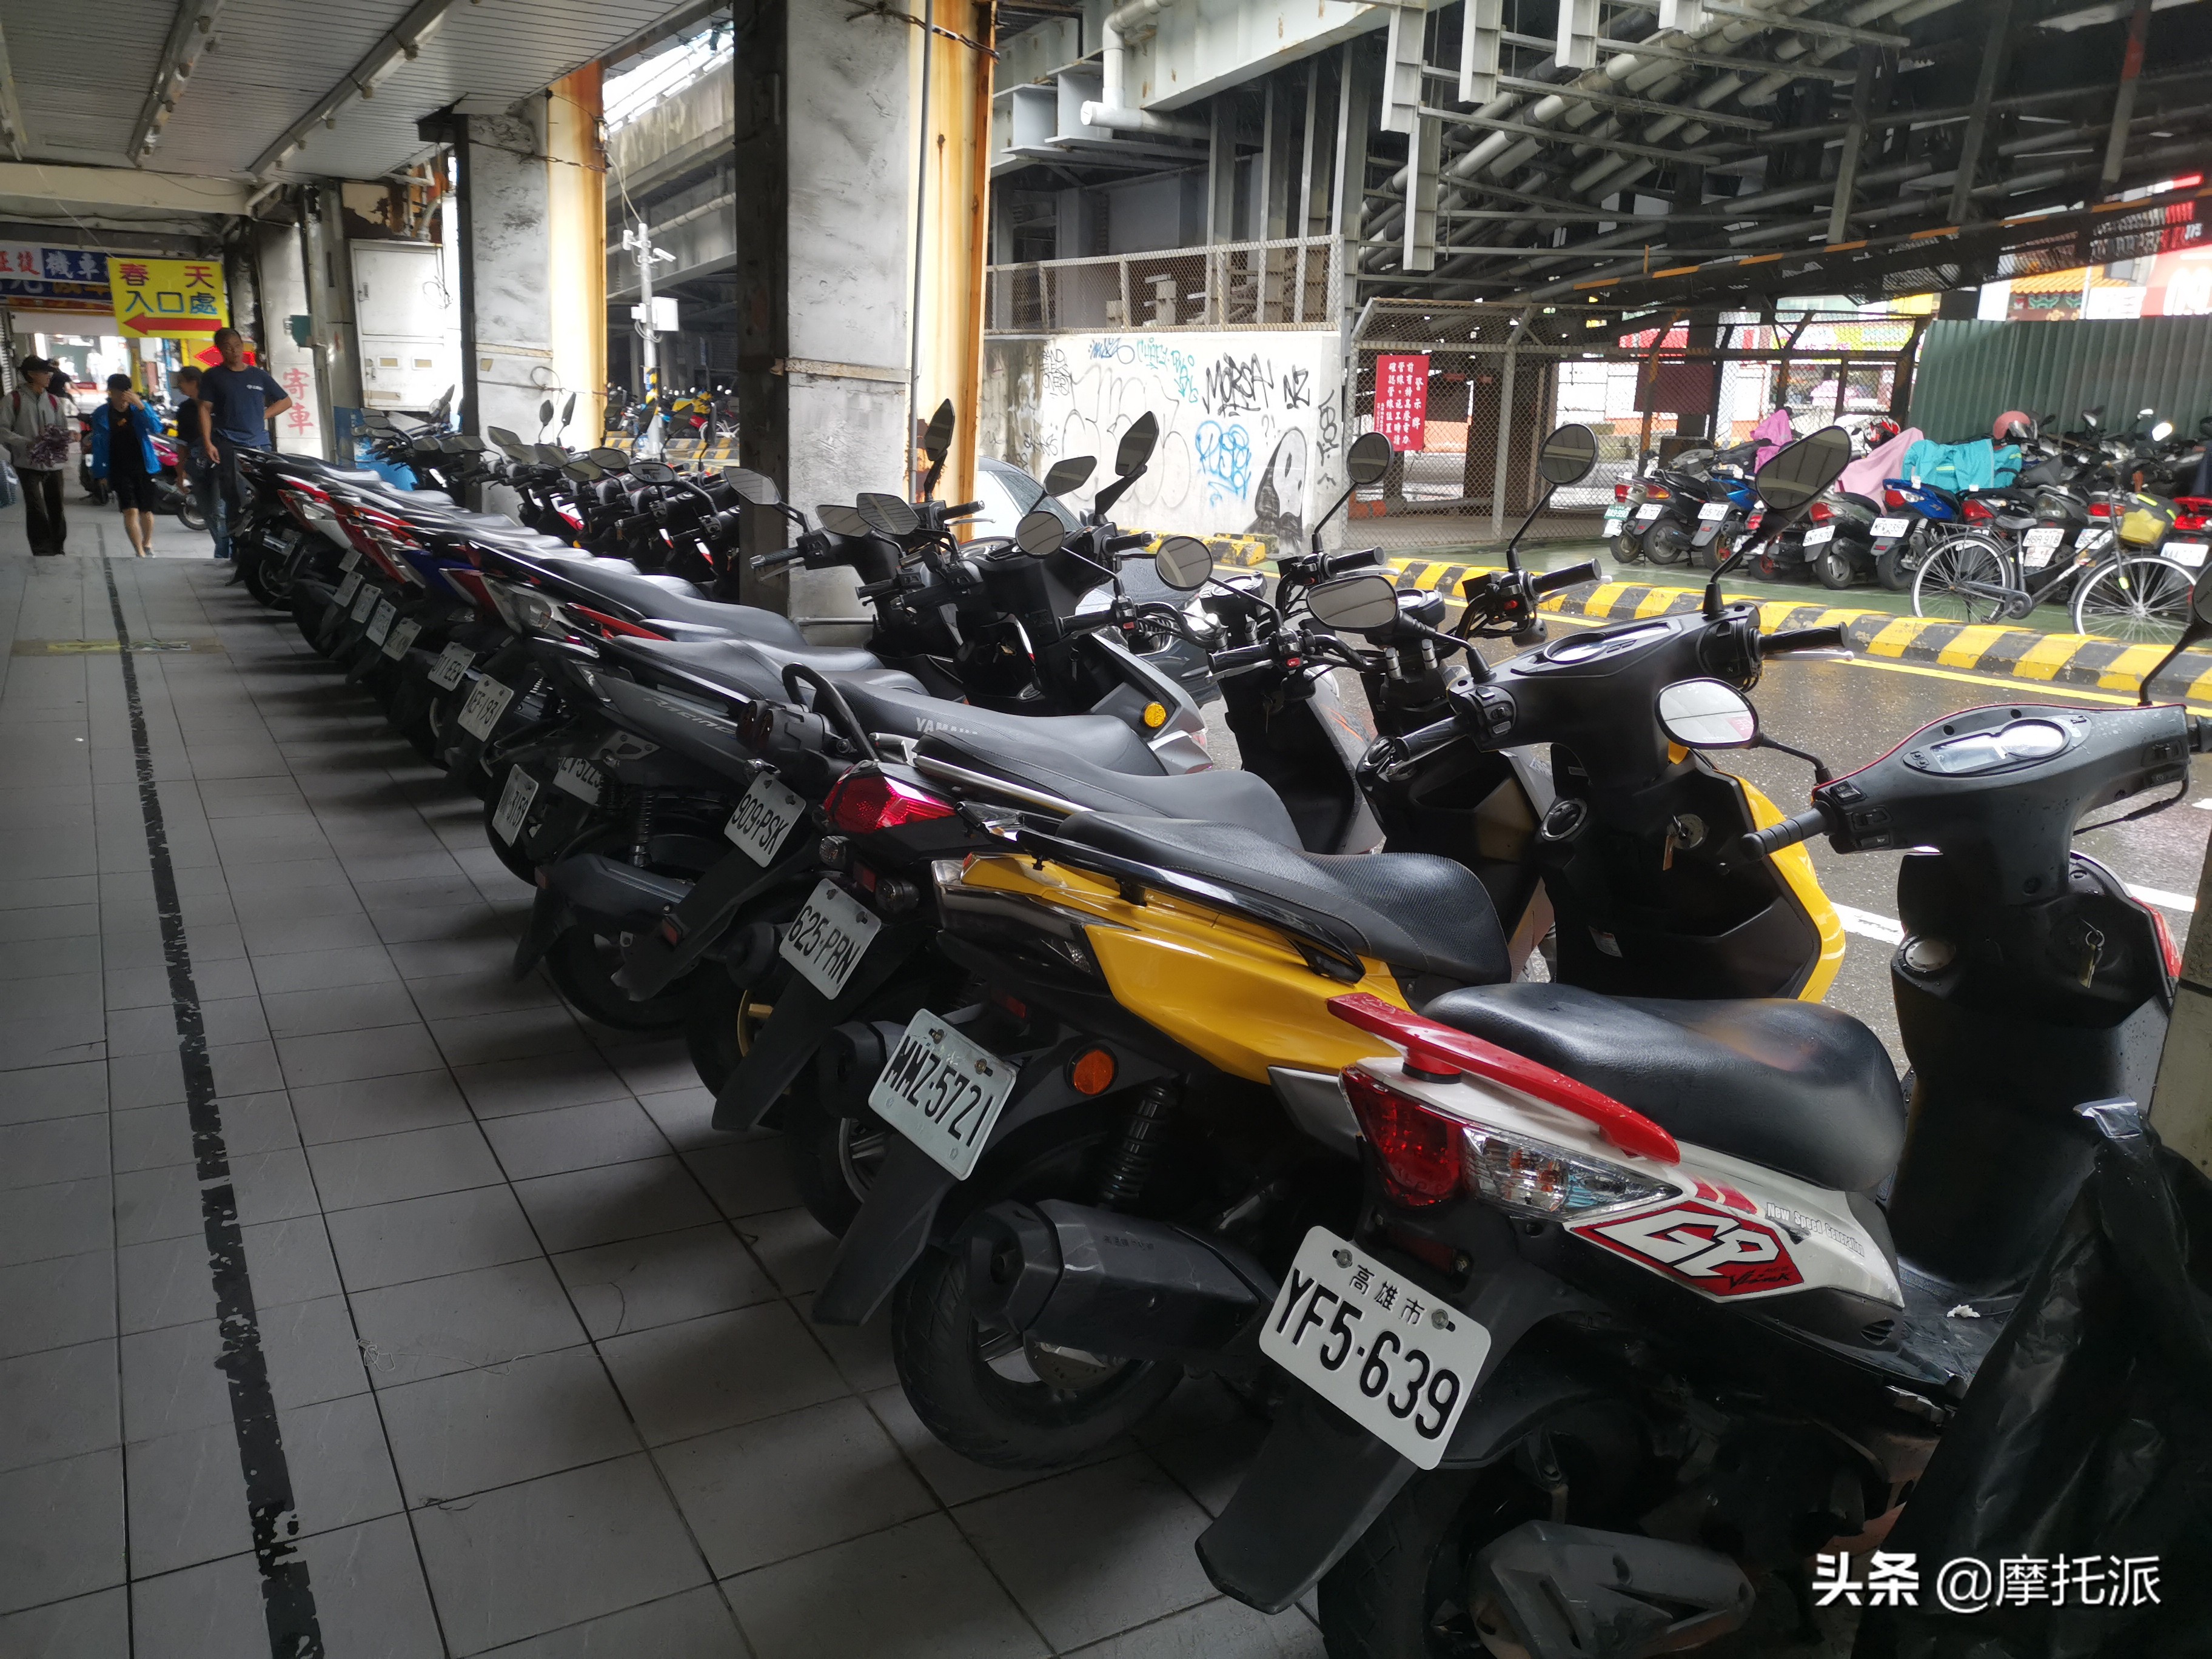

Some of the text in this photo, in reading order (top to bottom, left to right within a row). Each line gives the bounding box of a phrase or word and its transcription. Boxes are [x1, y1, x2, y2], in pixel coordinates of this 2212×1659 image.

[119, 263, 214, 289] 春天
[125, 290, 217, 315] 入口處
[283, 367, 314, 436] 寄車
[1412, 377, 1424, 430] 警示牌
[1767, 1202, 1865, 1258] New Speed Generation
[1349, 1264, 1426, 1326] 高雄市
